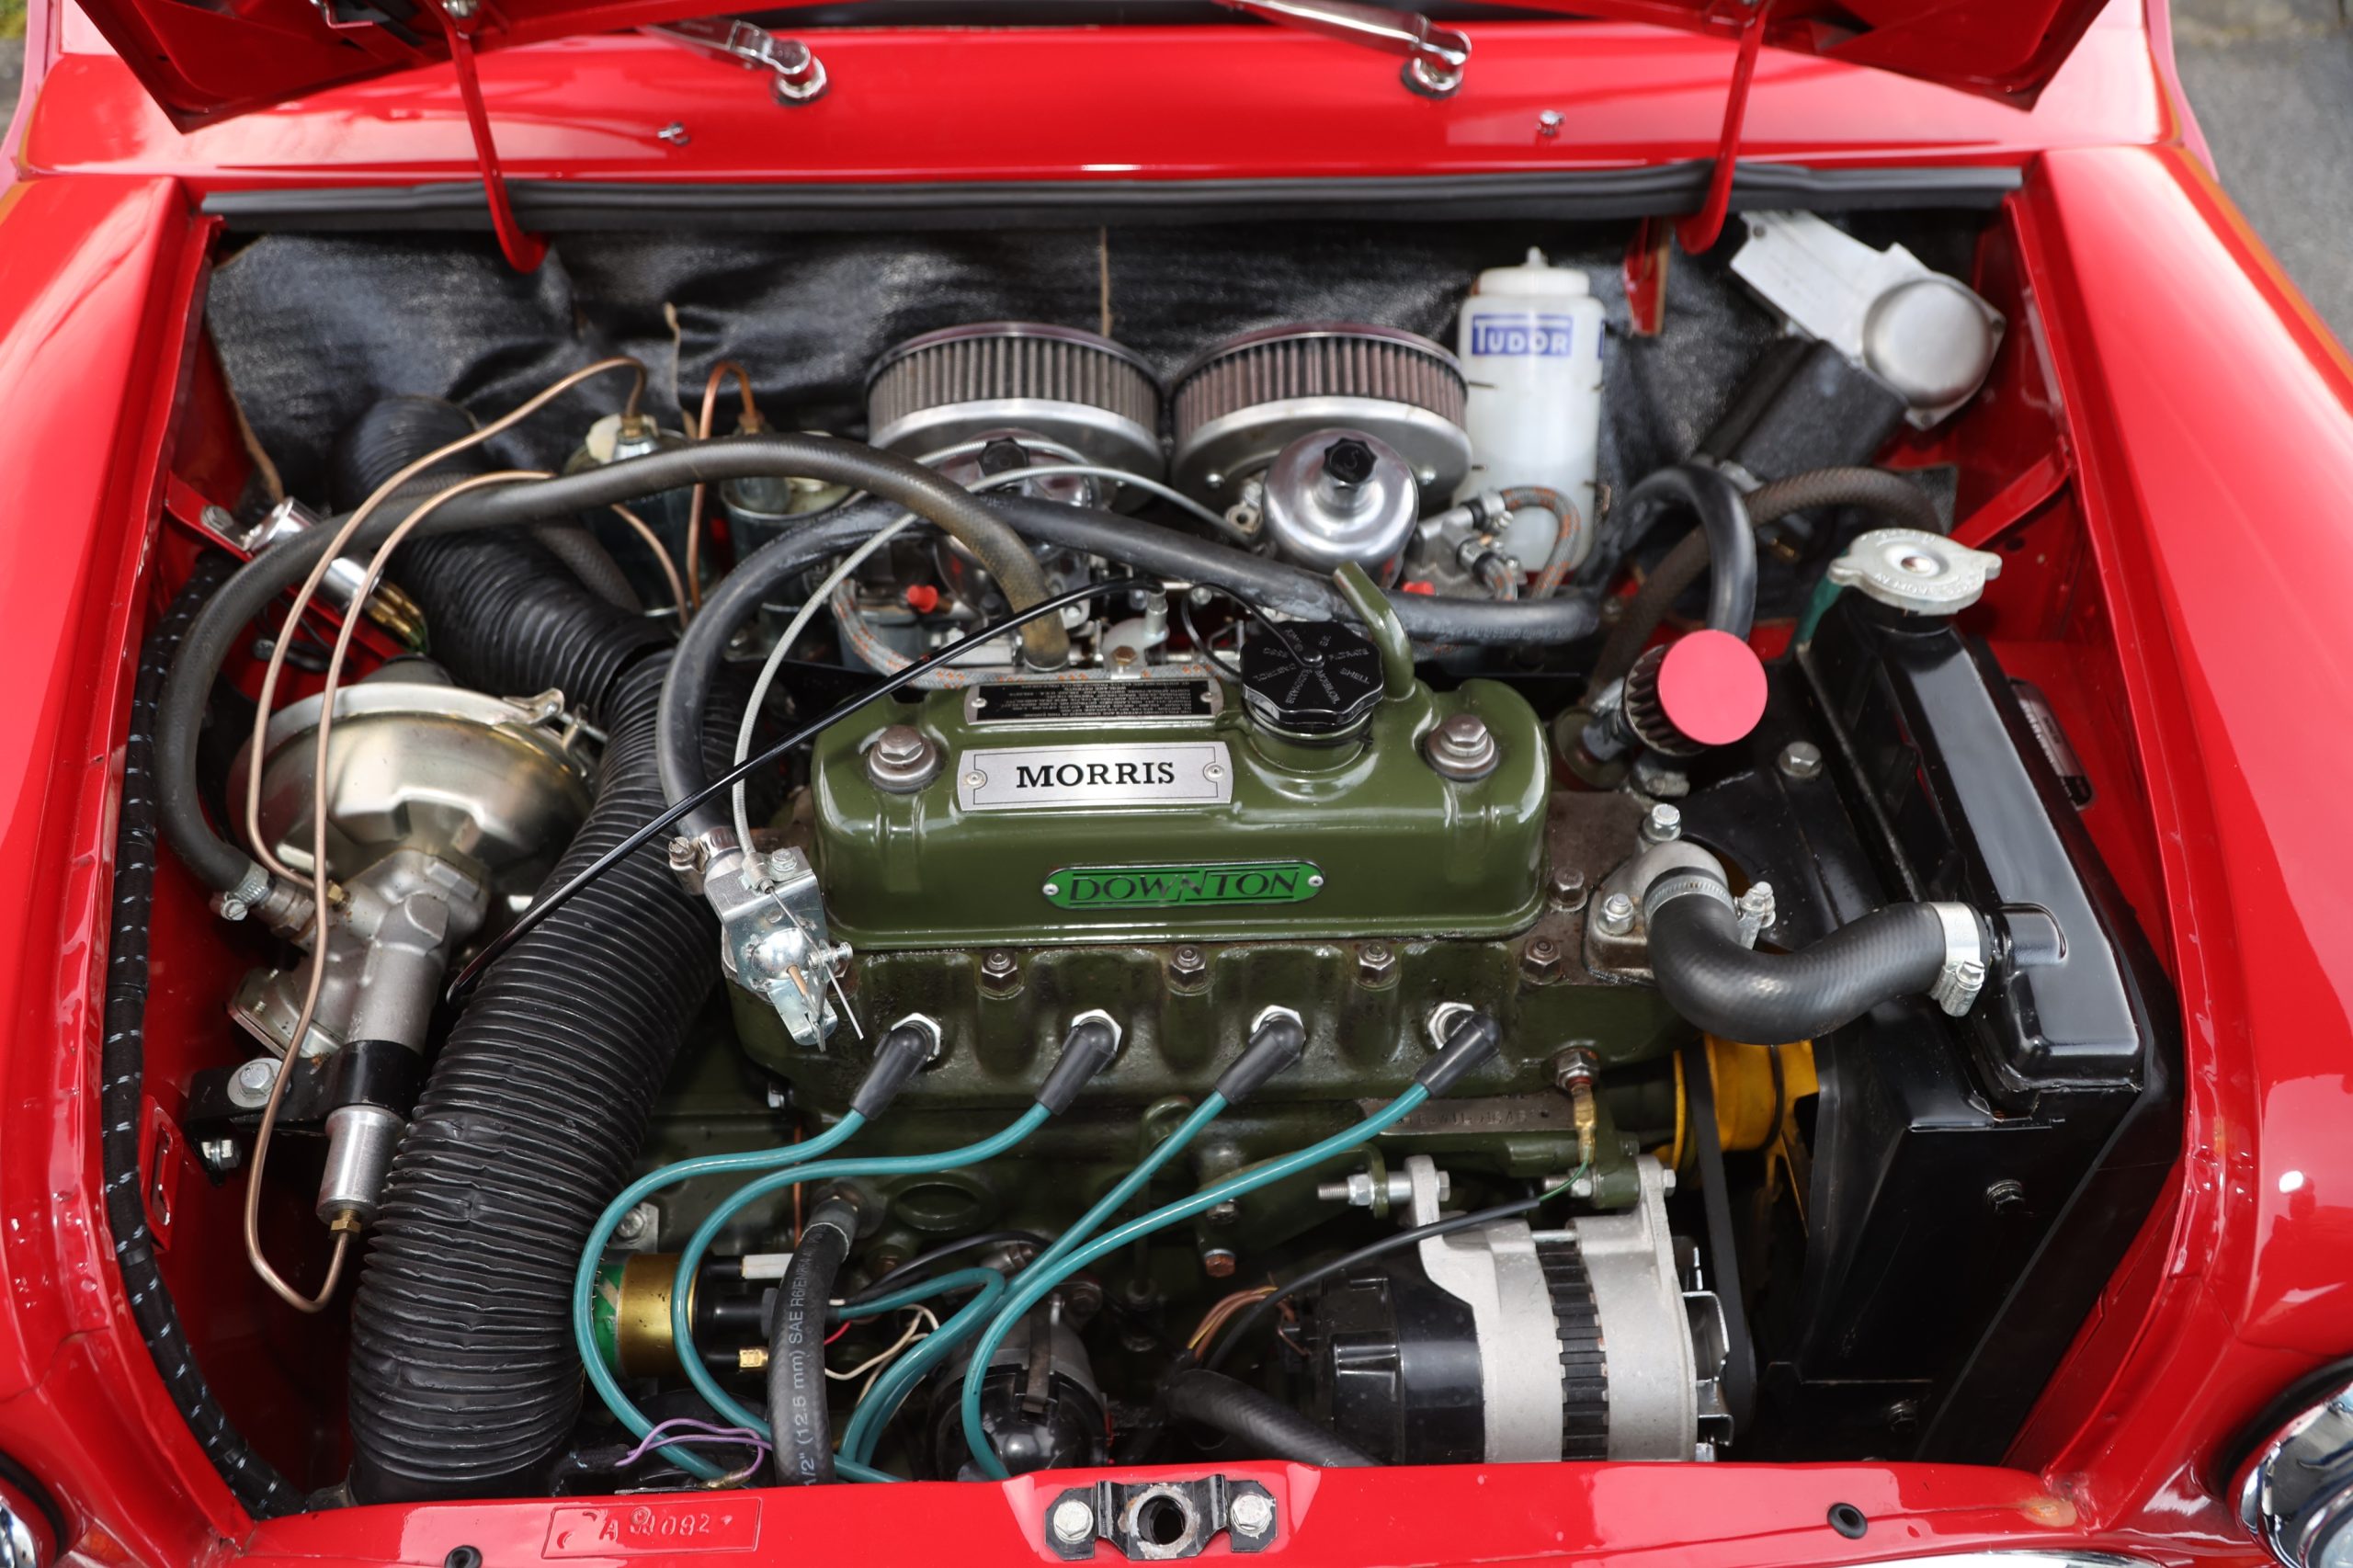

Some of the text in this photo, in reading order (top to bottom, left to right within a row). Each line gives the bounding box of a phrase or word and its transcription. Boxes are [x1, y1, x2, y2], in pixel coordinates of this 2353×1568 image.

[1473, 320, 1569, 353] TUDOR
[1339, 667, 1370, 685] SHELL
[1016, 762, 1176, 789] MORRIS
[1069, 869, 1299, 902] DOWNTON
[789, 1311, 804, 1345] SAE
[790, 1349, 807, 1390] mm)
[792, 1396, 814, 1445] (12.5
